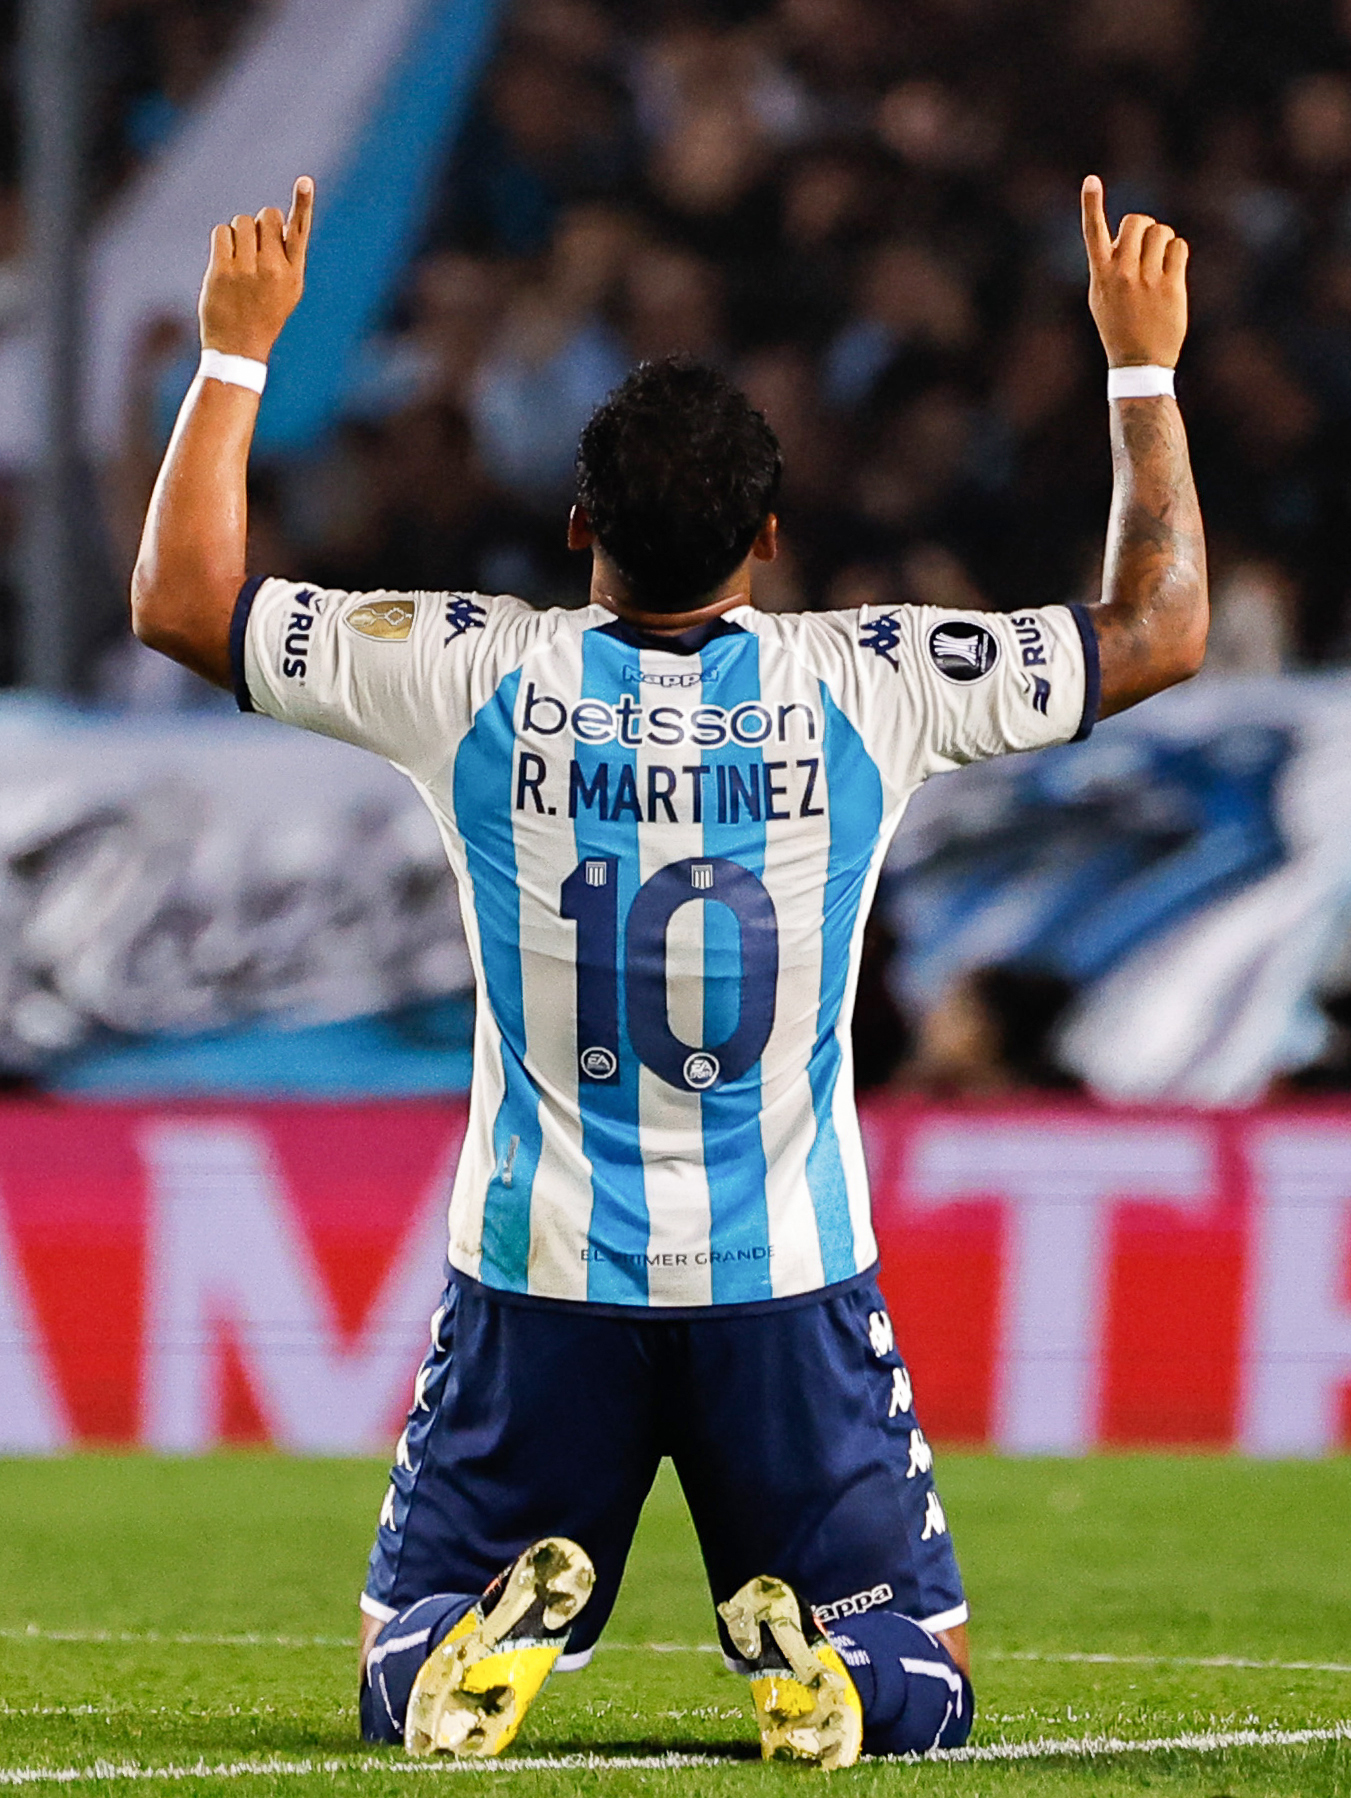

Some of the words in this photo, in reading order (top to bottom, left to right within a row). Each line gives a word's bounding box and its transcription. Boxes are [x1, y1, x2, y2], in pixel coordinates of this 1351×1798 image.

[283, 612, 314, 678] RUS
[1011, 617, 1046, 667] RUS
[521, 682, 817, 747] betsson
[567, 758, 825, 824] MARTINEZ
[560, 857, 779, 1093] 10
[587, 1053, 610, 1068] EA
[580, 1249, 606, 1262] EL
[694, 1245, 775, 1265] GRANDE
[811, 1583, 893, 1623] appa
